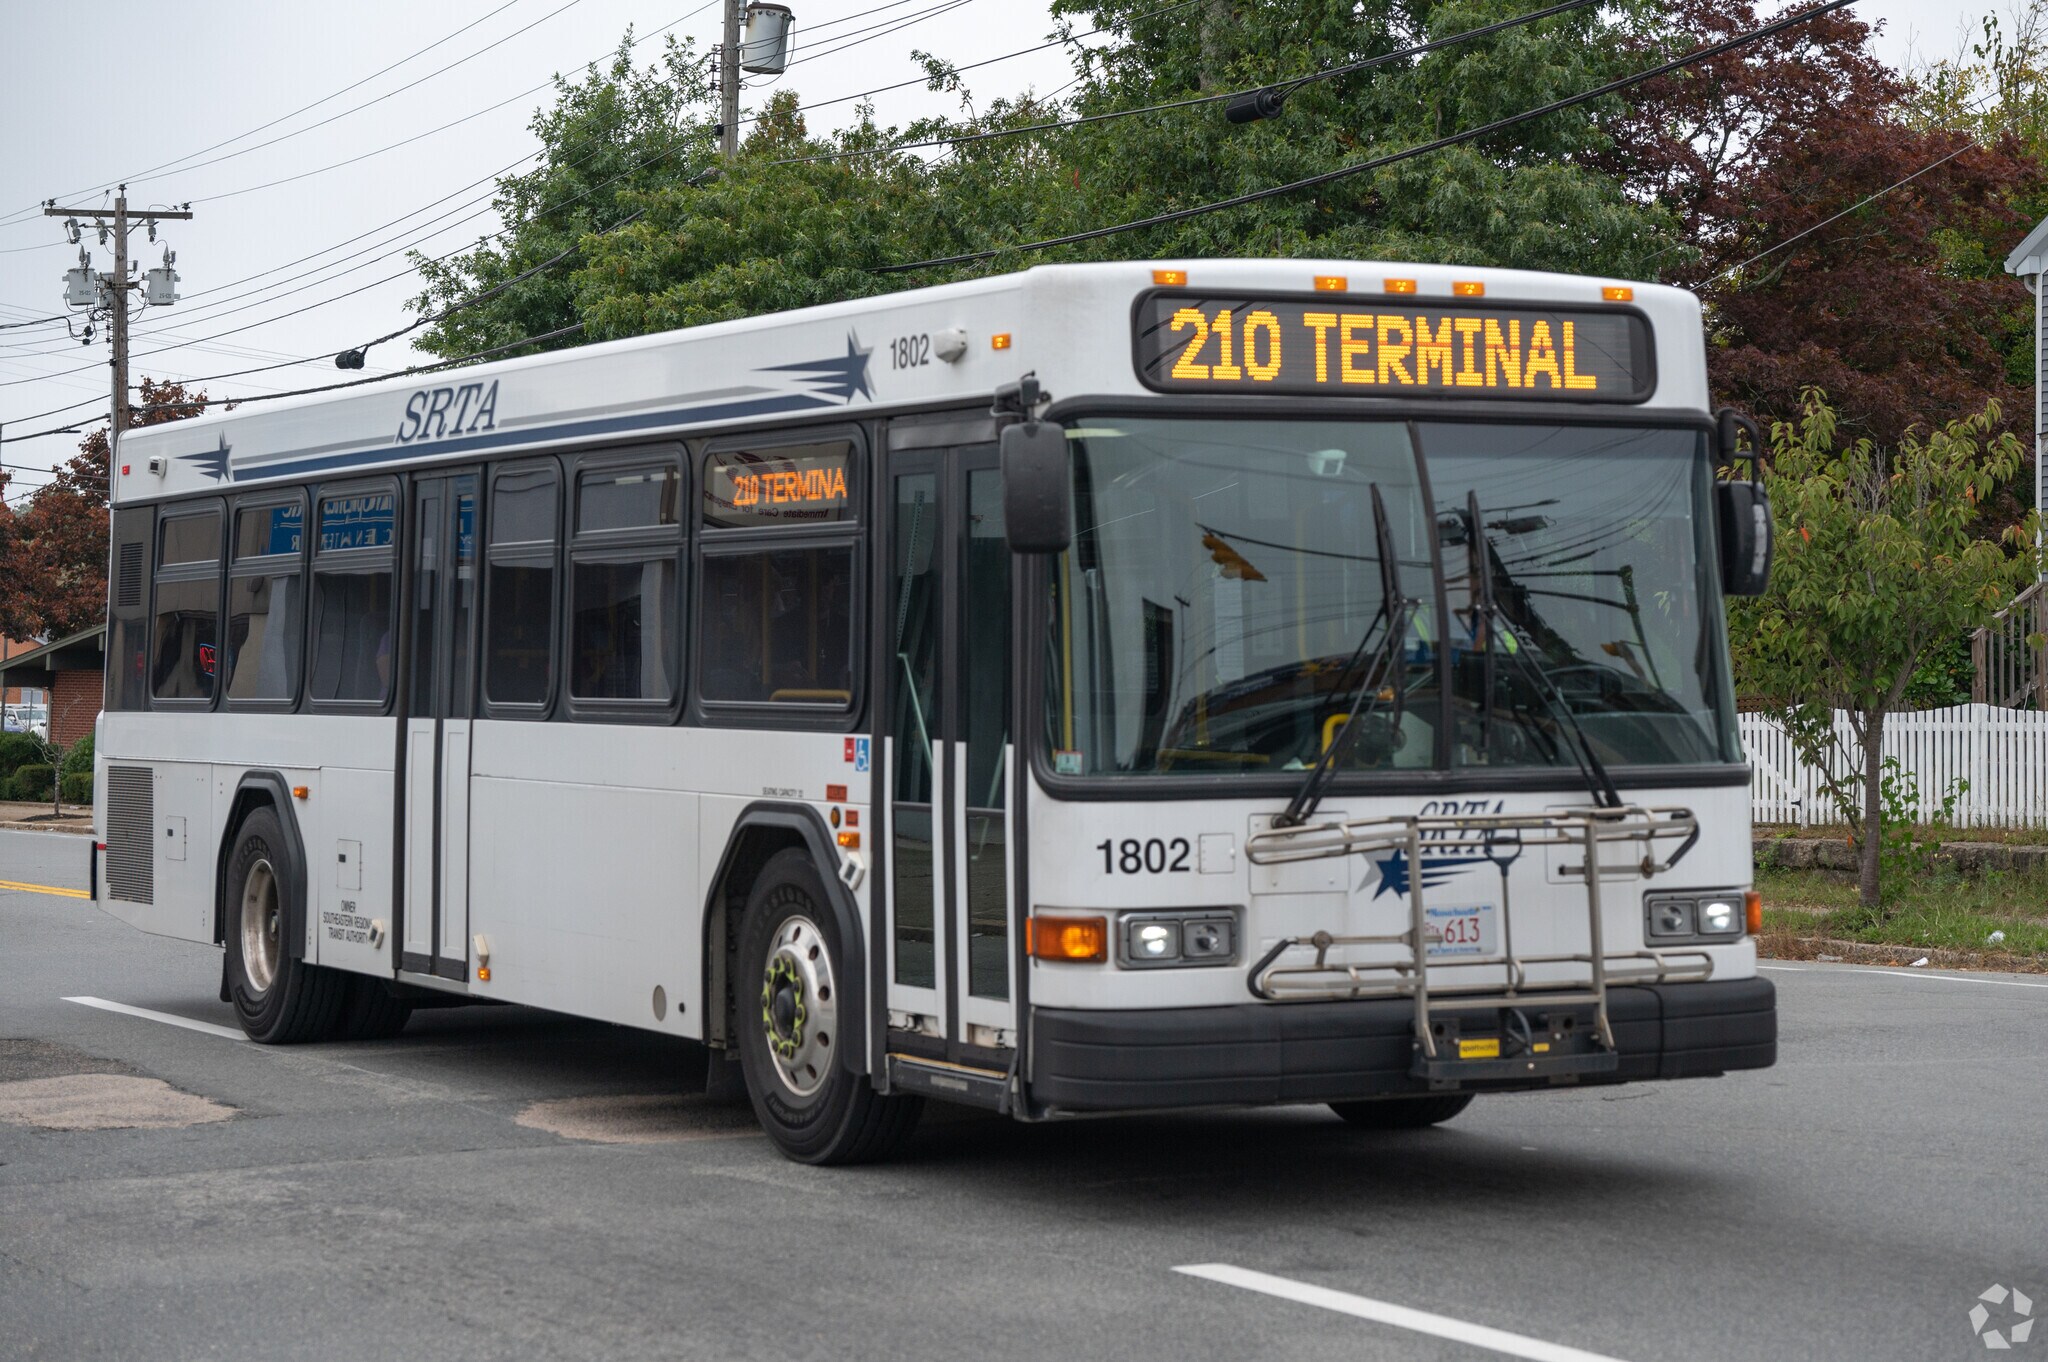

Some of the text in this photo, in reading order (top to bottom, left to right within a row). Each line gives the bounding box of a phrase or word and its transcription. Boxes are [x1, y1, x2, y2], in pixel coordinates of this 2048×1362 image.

[890, 333, 929, 370] 1802
[1171, 308, 1597, 390] 210 TERMINAL
[396, 379, 499, 444] SRTA
[733, 467, 848, 506] 210 TERMINA
[1096, 837, 1190, 874] 1802
[341, 900, 356, 913] OWNER
[1444, 918, 1480, 944] 613
